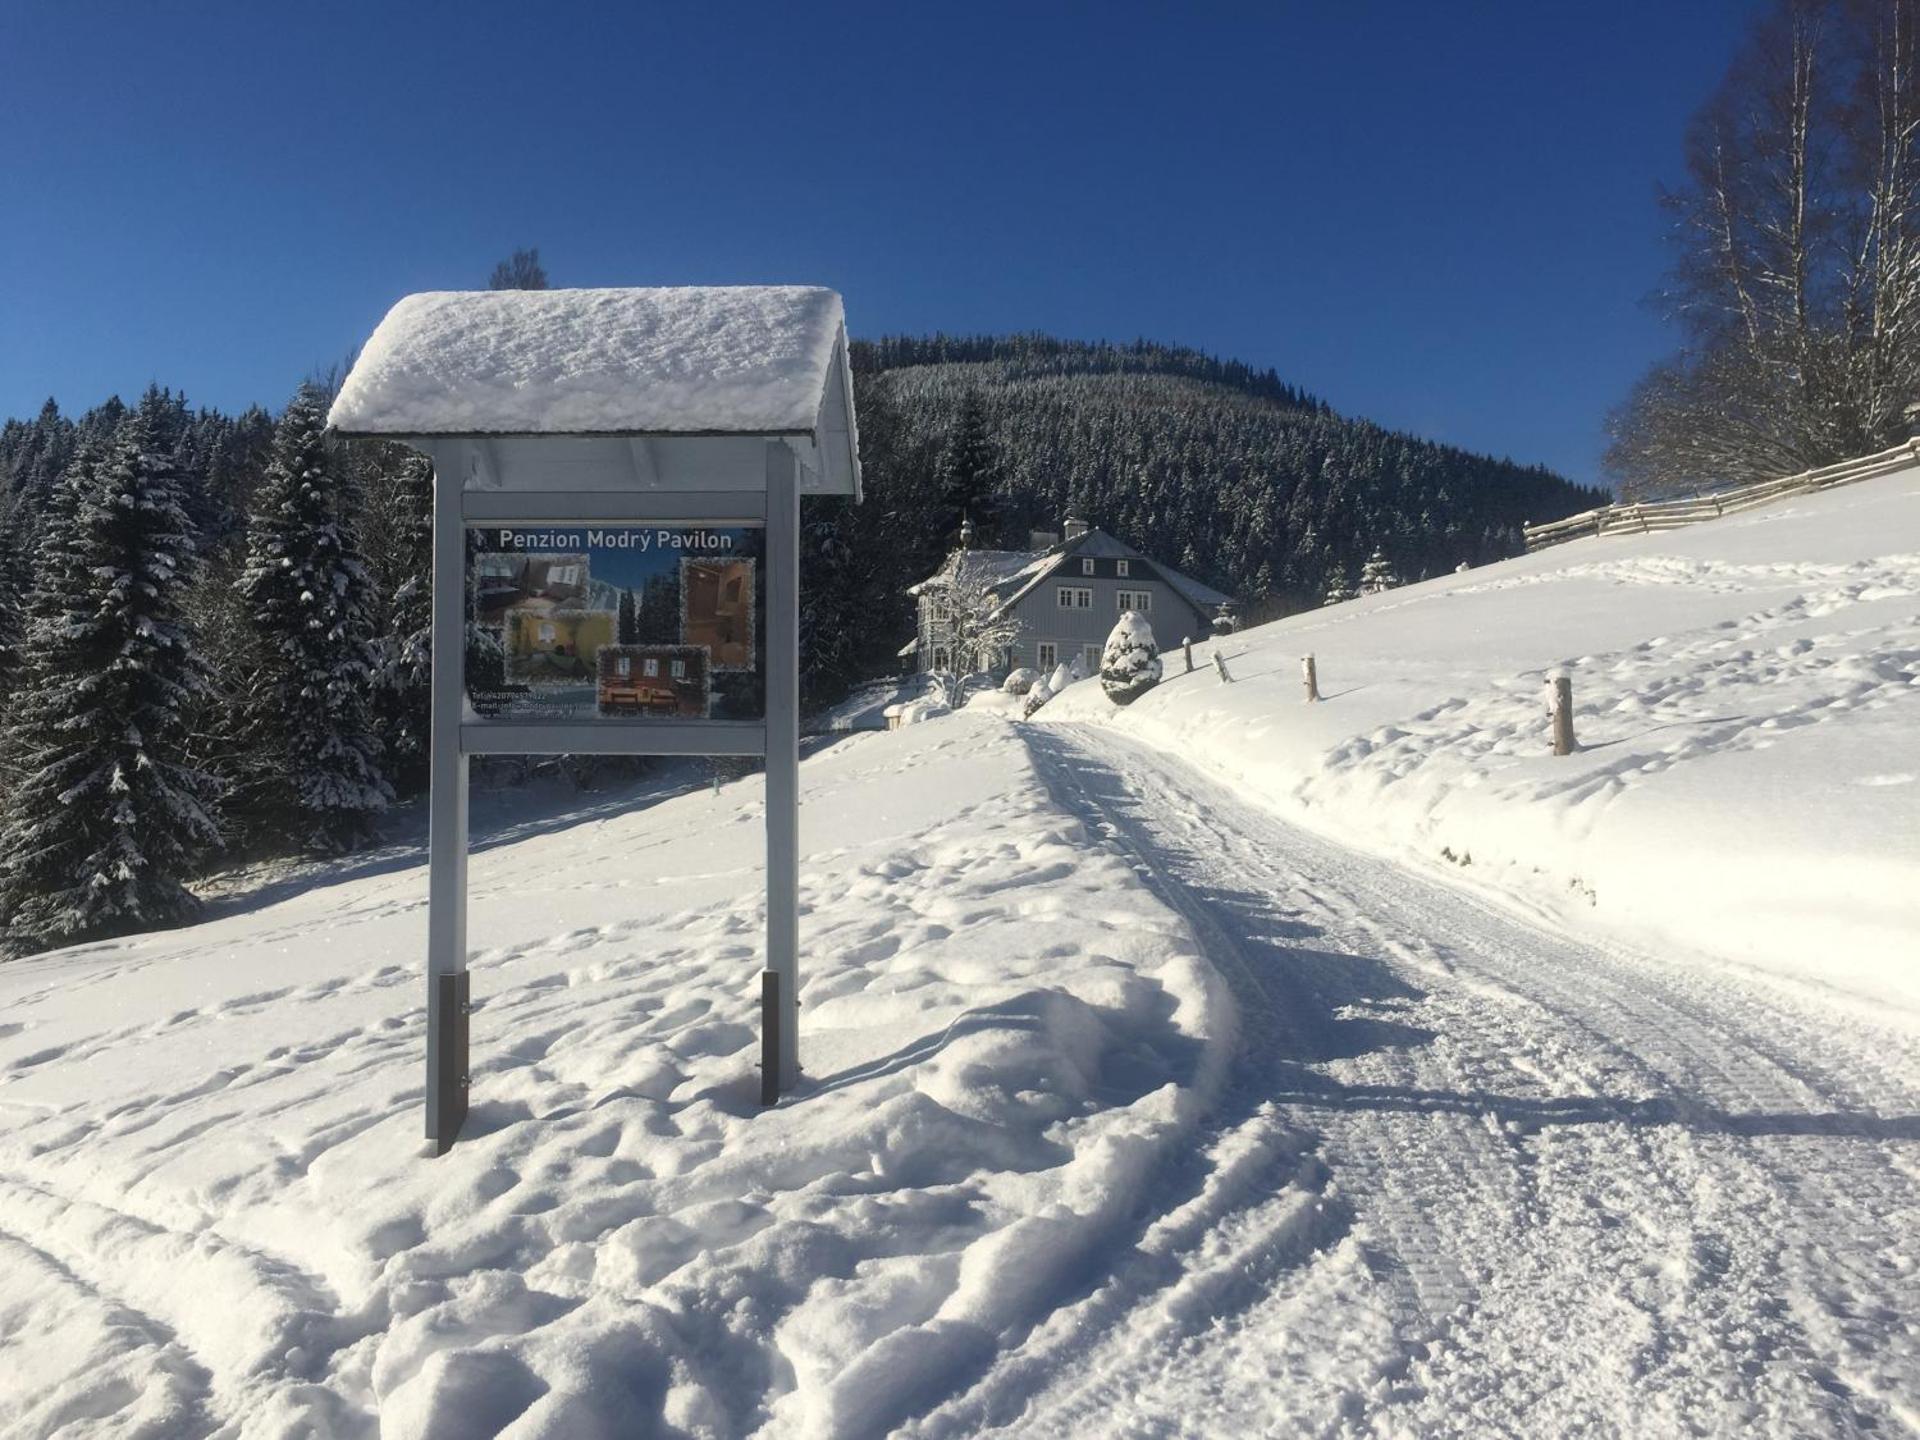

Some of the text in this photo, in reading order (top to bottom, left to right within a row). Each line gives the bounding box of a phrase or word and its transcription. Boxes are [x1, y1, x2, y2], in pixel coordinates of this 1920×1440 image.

[500, 529, 732, 552] Penzion Modrý Pavilon
